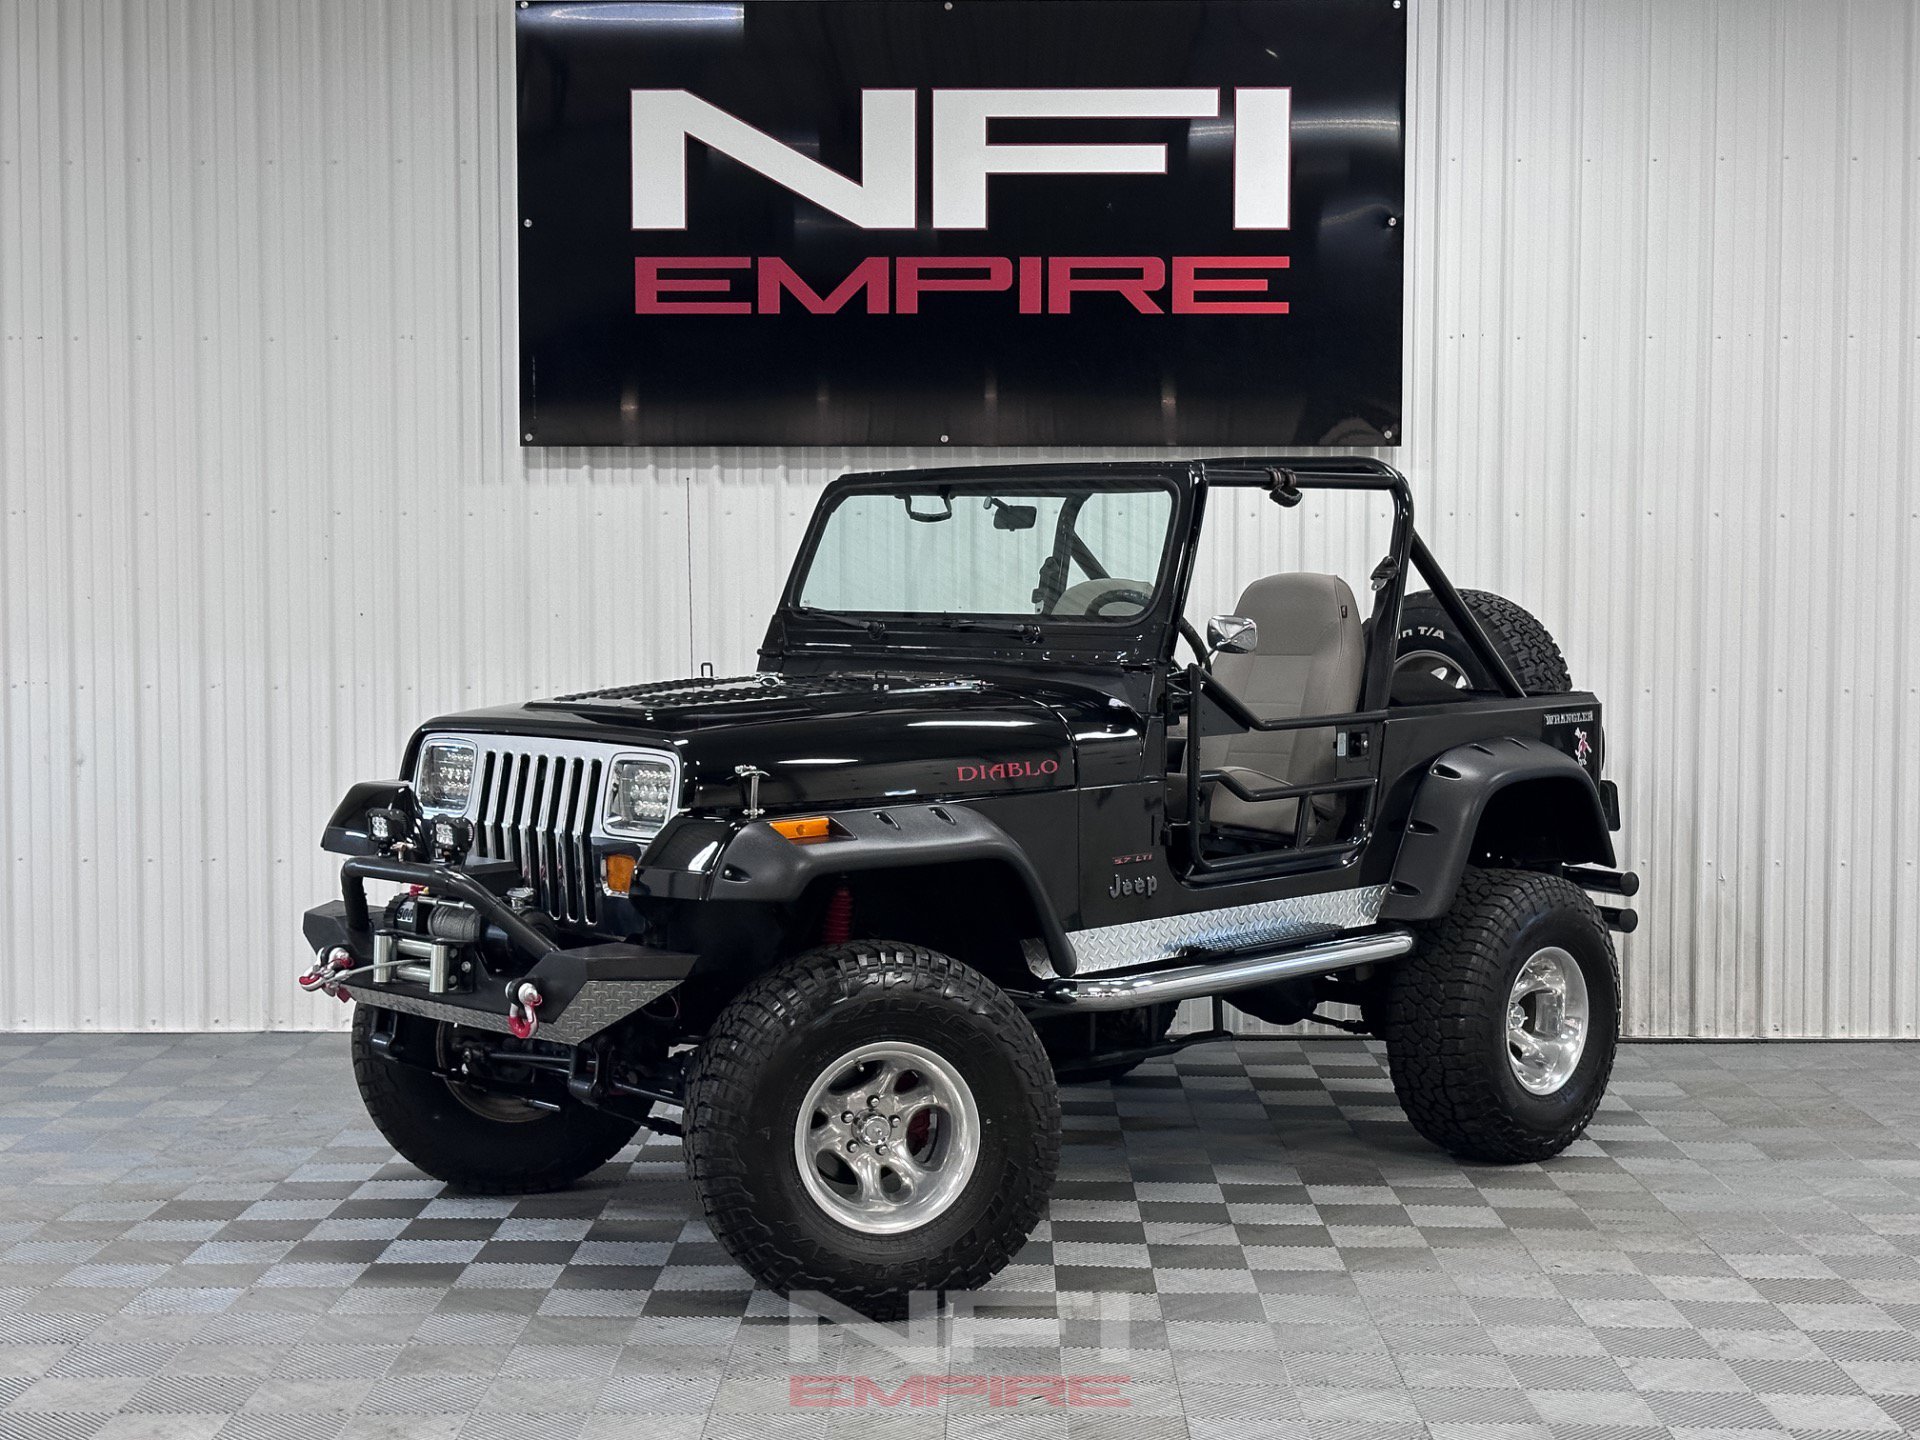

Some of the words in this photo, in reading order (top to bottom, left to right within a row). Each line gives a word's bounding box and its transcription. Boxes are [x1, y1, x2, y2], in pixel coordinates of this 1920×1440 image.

[630, 87, 1292, 231] NFI
[634, 256, 1291, 315] EMPIRE
[1544, 710, 1593, 726] WRANGLER
[957, 759, 1058, 782] DIABLO
[1109, 873, 1158, 899] Jeep
